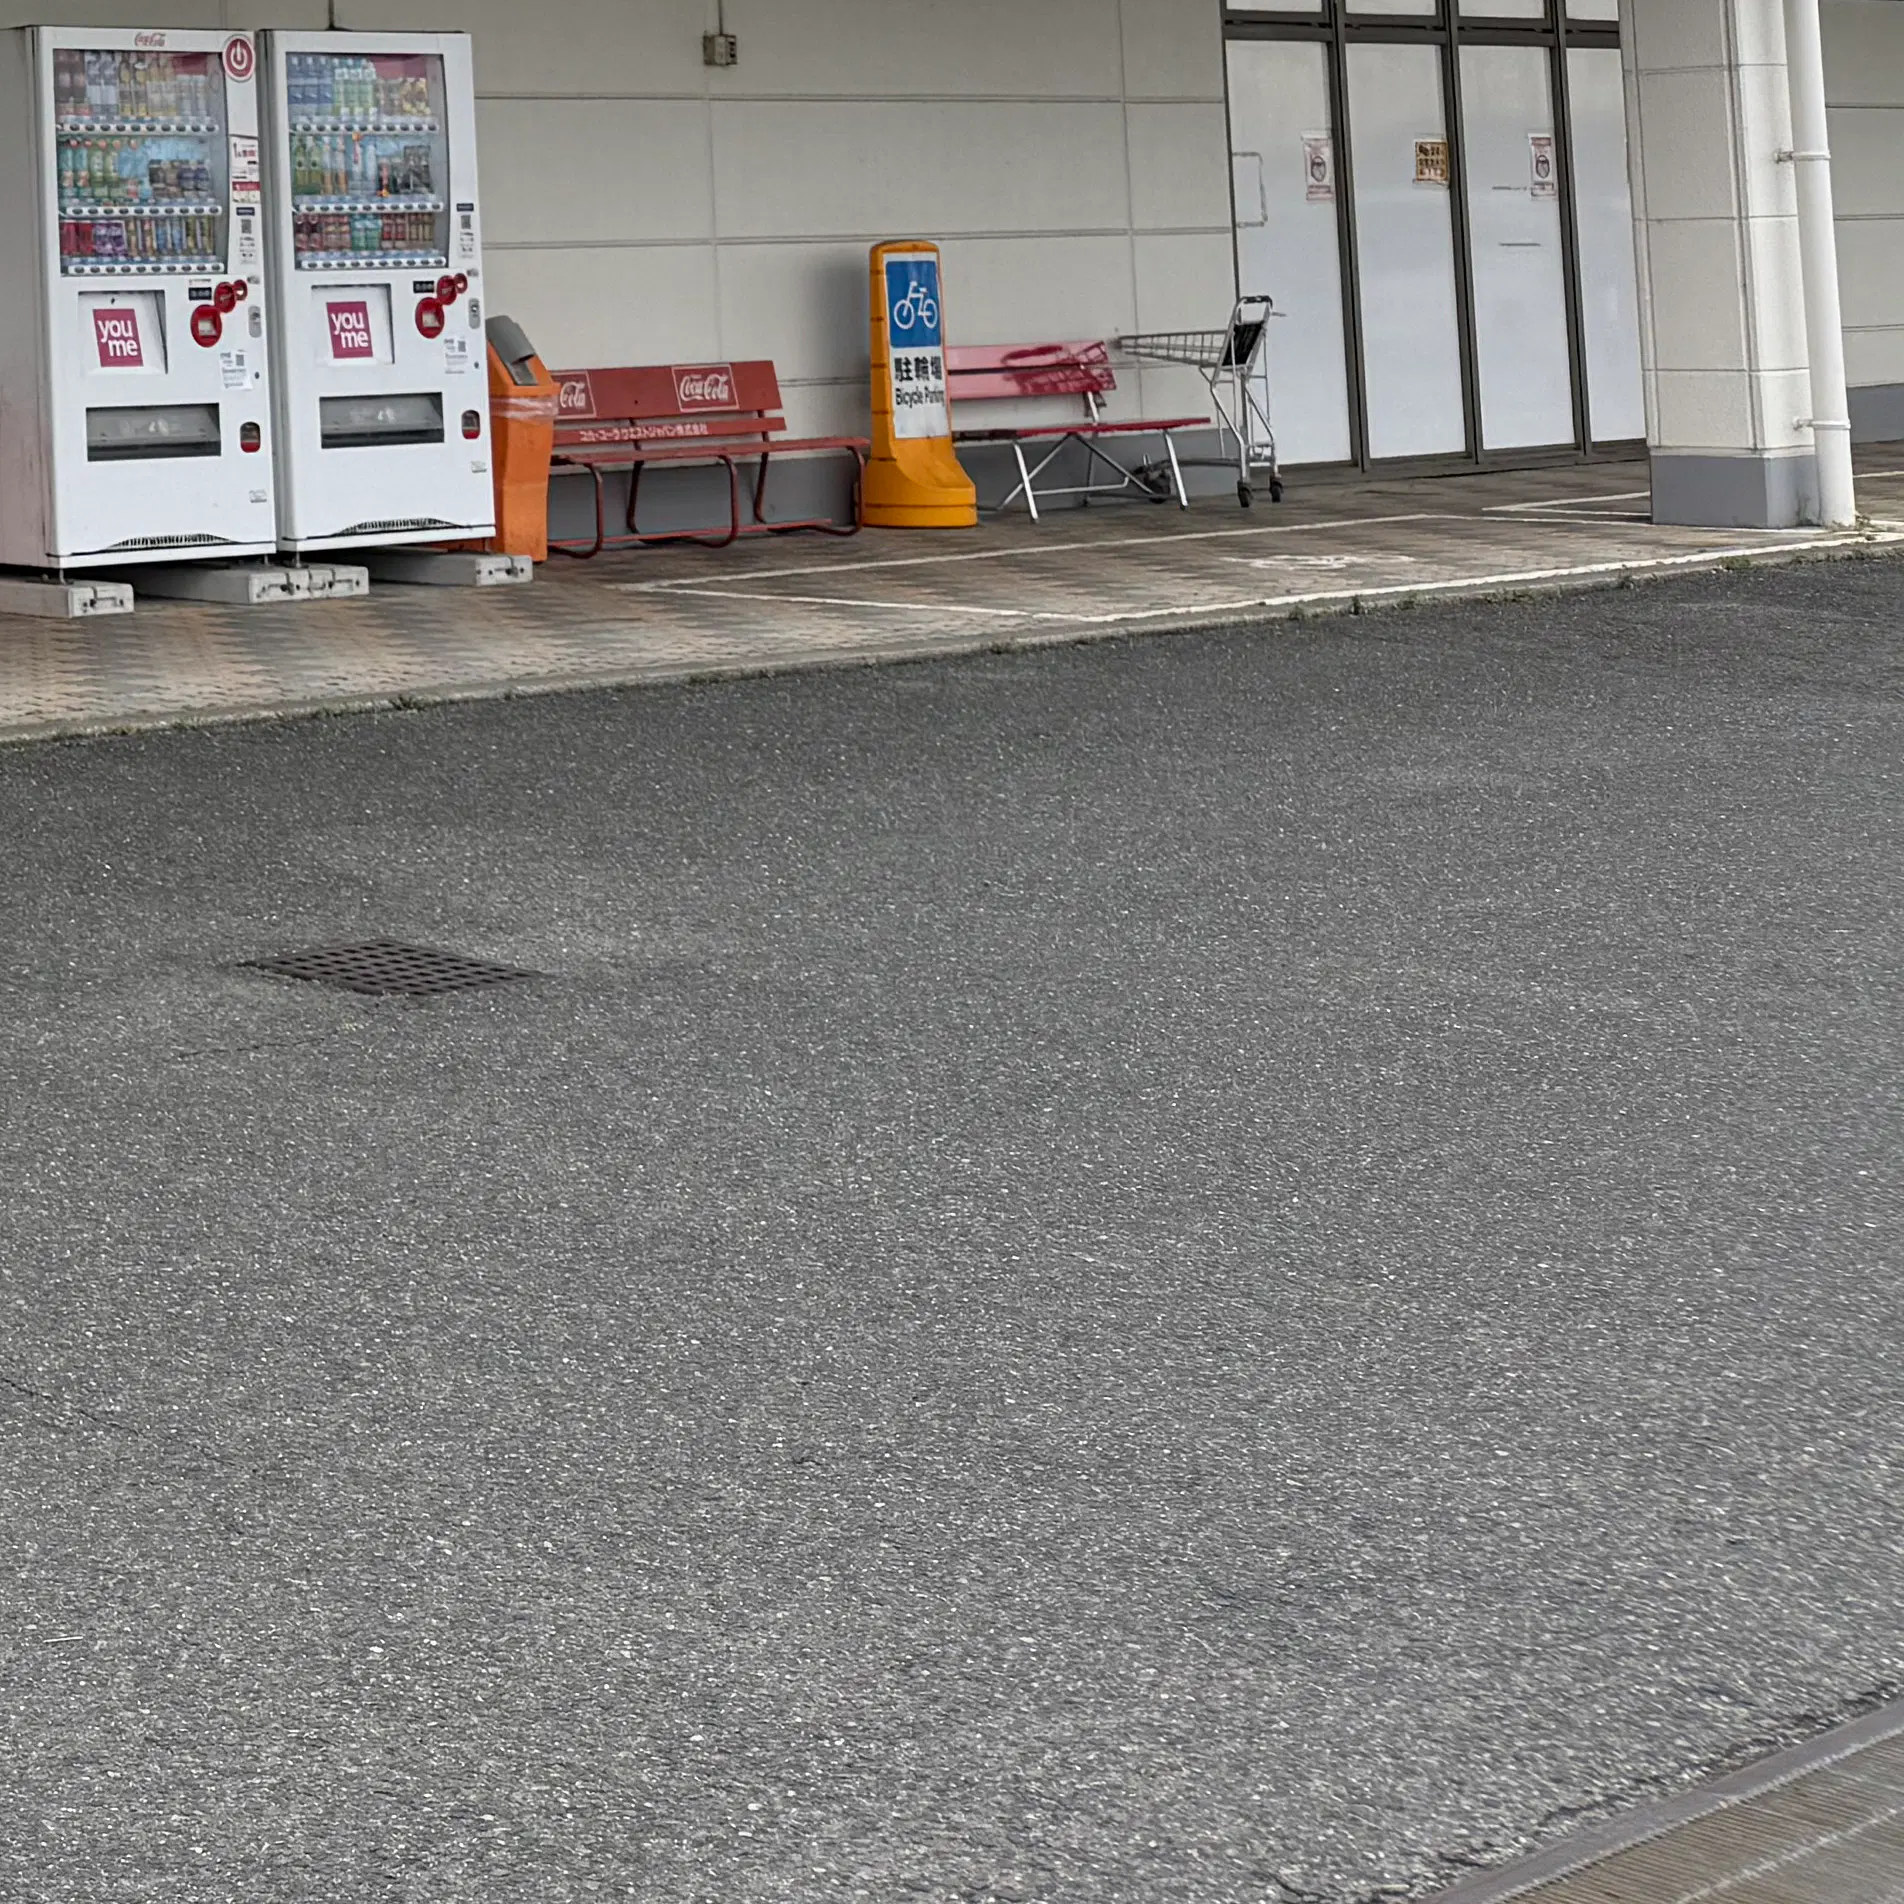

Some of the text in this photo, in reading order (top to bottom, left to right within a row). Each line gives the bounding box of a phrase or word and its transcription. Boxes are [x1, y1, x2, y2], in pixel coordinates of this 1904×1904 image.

[97, 319, 134, 343] you
[330, 312, 364, 335] you
[108, 338, 139, 357] me
[340, 330, 369, 349] me
